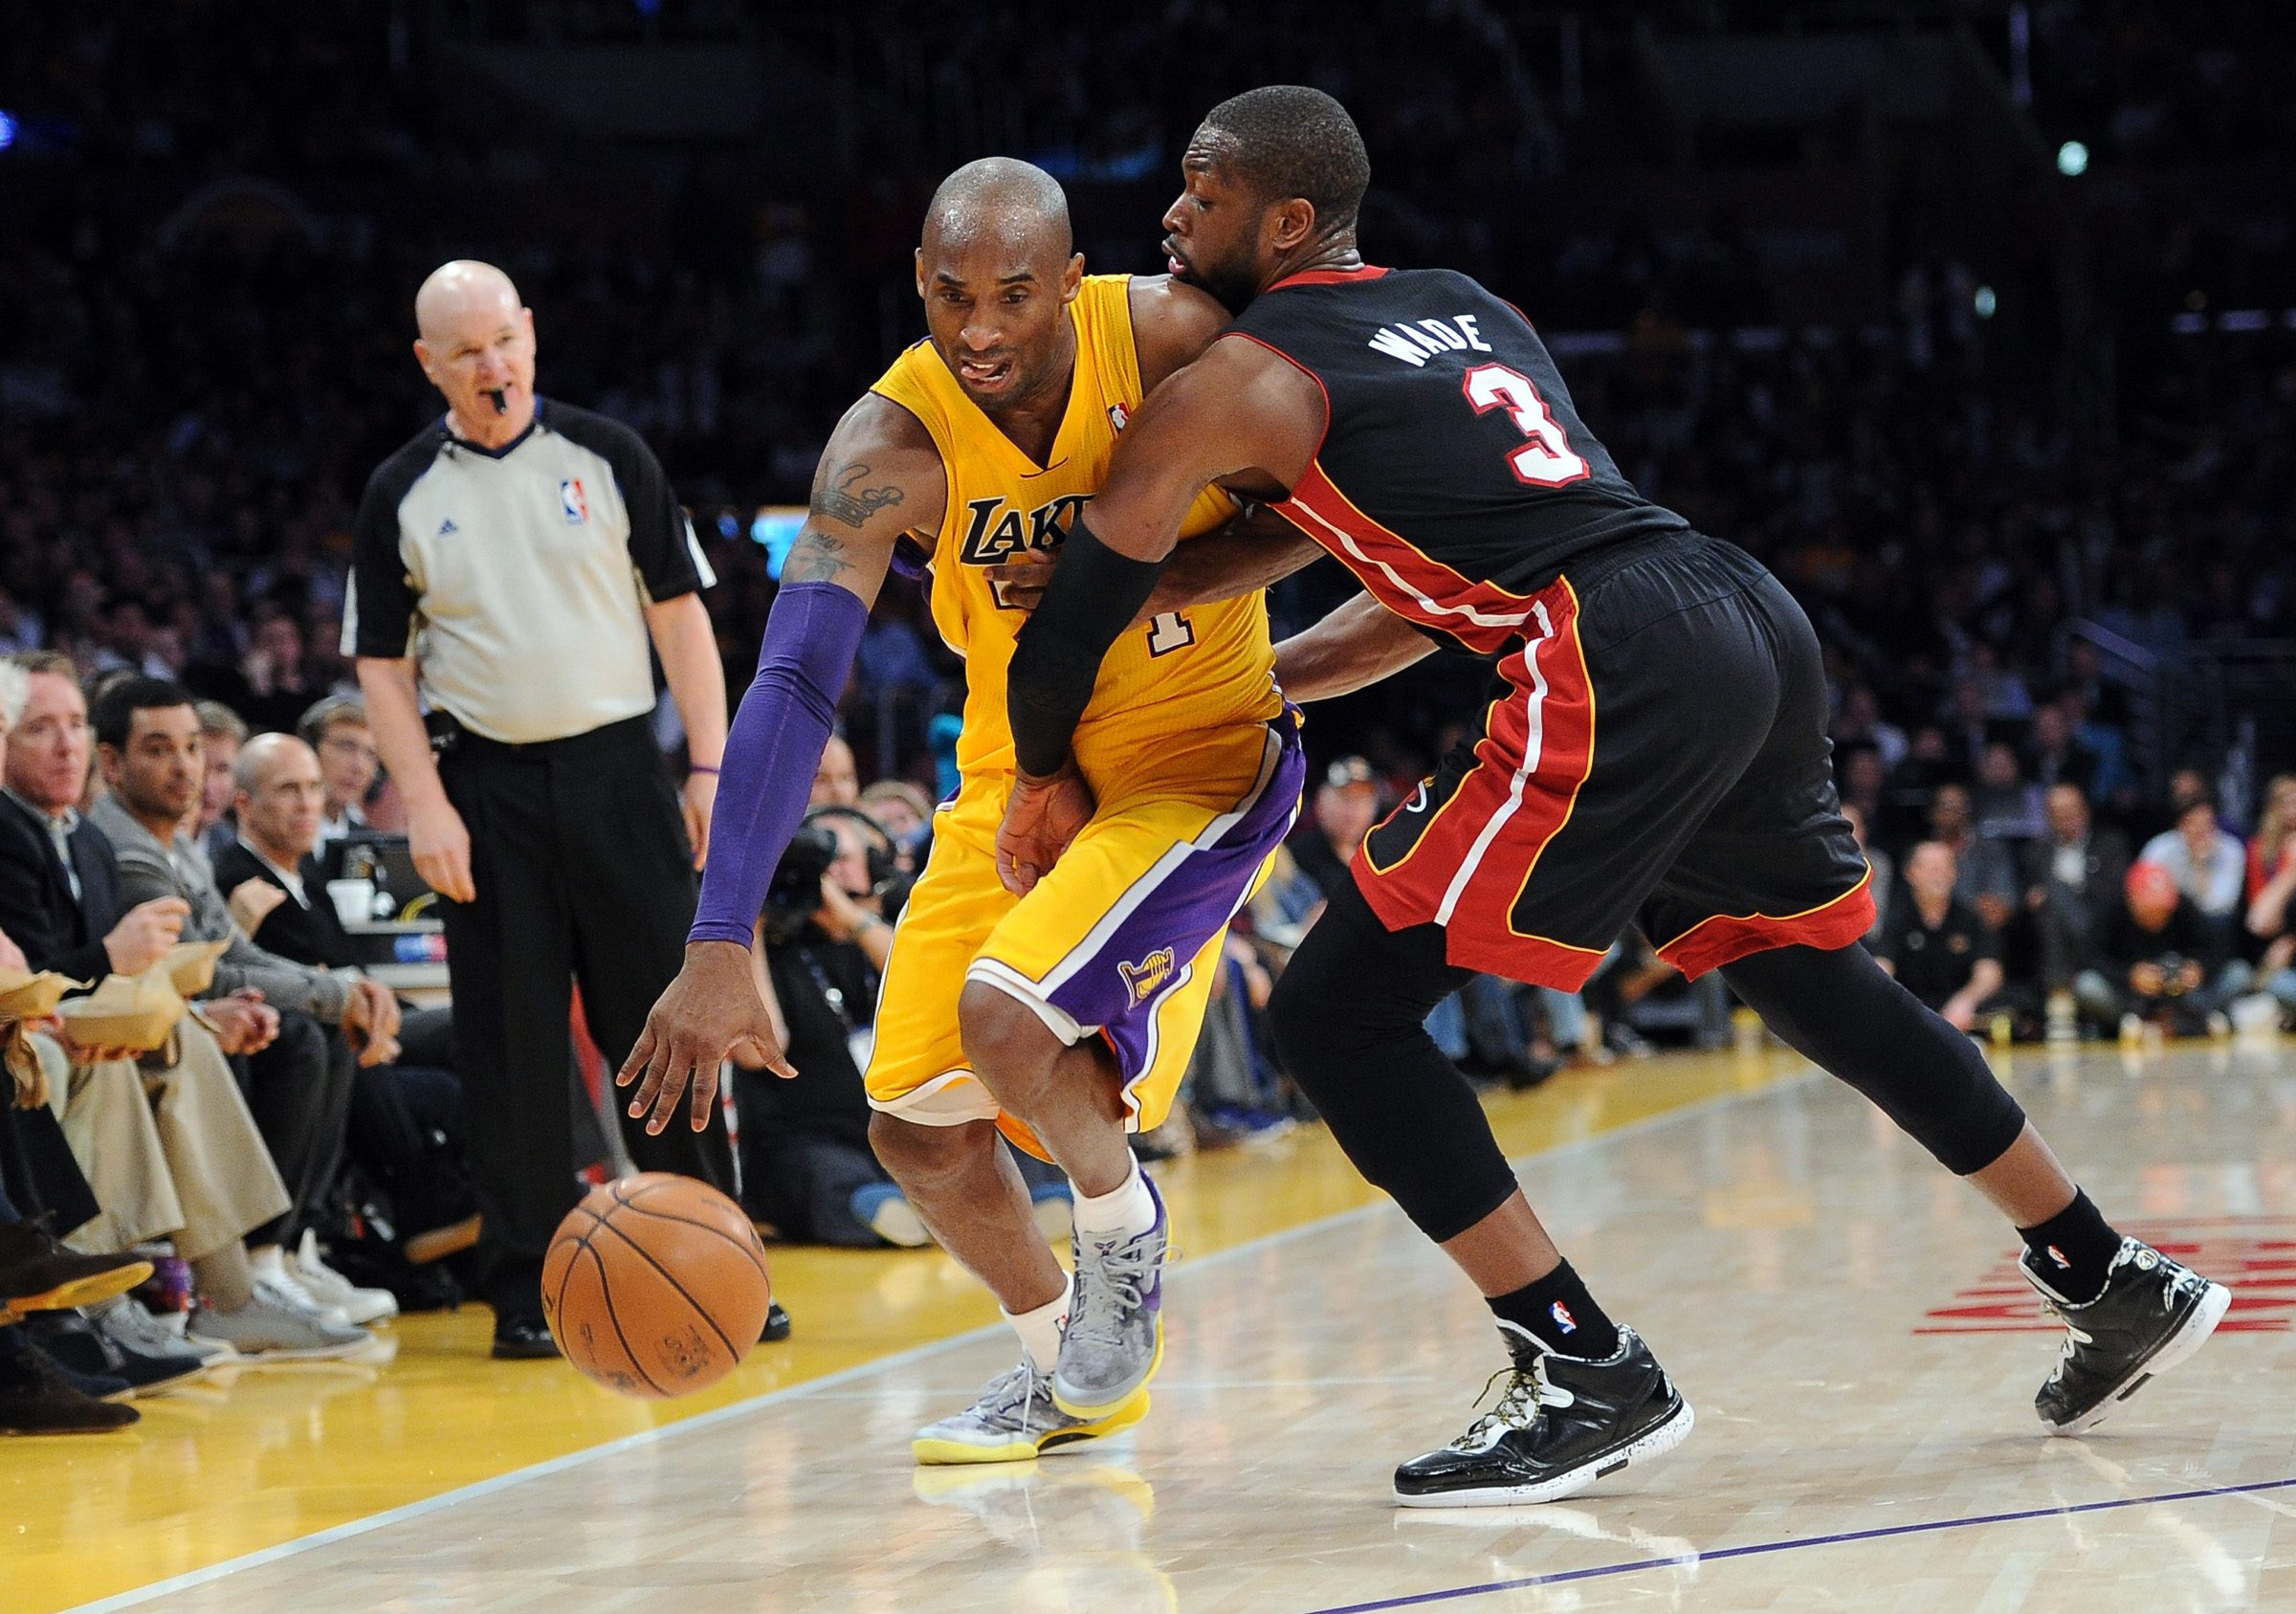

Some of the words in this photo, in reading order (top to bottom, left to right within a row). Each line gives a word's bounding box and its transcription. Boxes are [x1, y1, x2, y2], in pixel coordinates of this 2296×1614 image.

[1368, 315, 1492, 367] WADE
[1462, 362, 1591, 489] 3
[960, 493, 1095, 566] LAK
